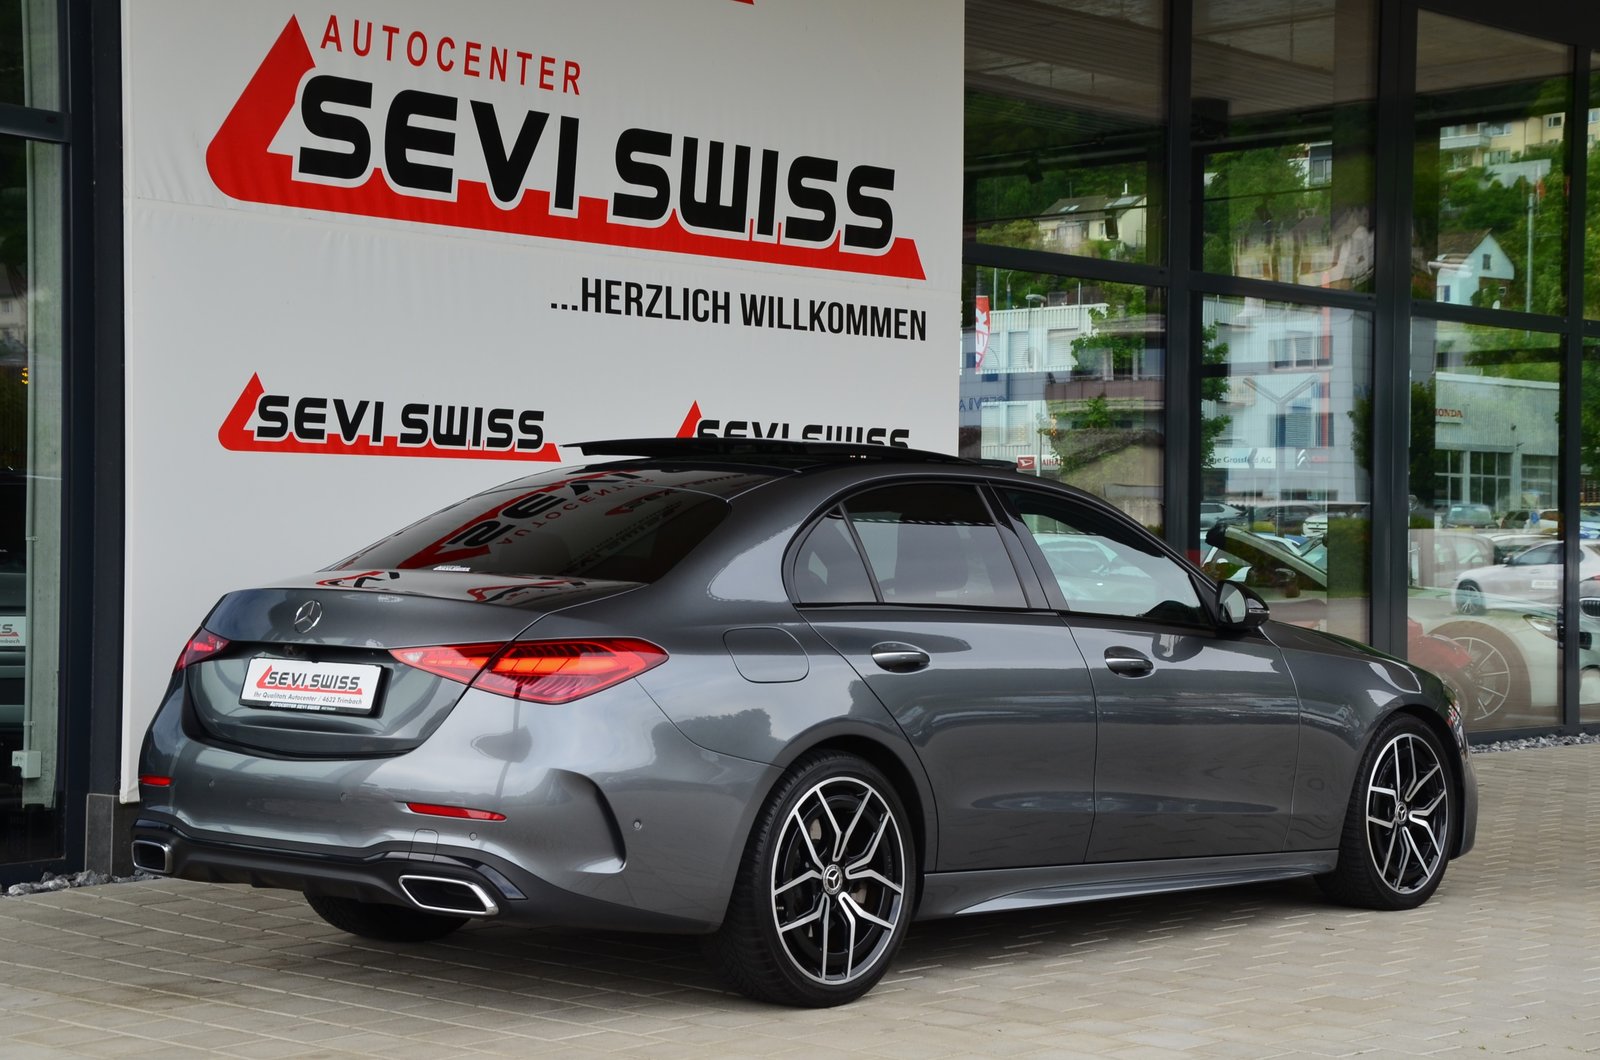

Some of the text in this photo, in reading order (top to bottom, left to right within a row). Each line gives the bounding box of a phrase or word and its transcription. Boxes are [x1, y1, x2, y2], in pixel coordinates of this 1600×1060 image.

[320, 15, 581, 96] AUTOCENTER
[298, 74, 895, 250] SEVI SWISS
[551, 277, 730, 325] ...HERZLICH
[740, 293, 926, 341] WILLKOMMEN
[256, 395, 545, 450] SEVI SWISS
[267, 671, 361, 691] SEVI SWISS
[337, 697, 363, 705] Trimbach
